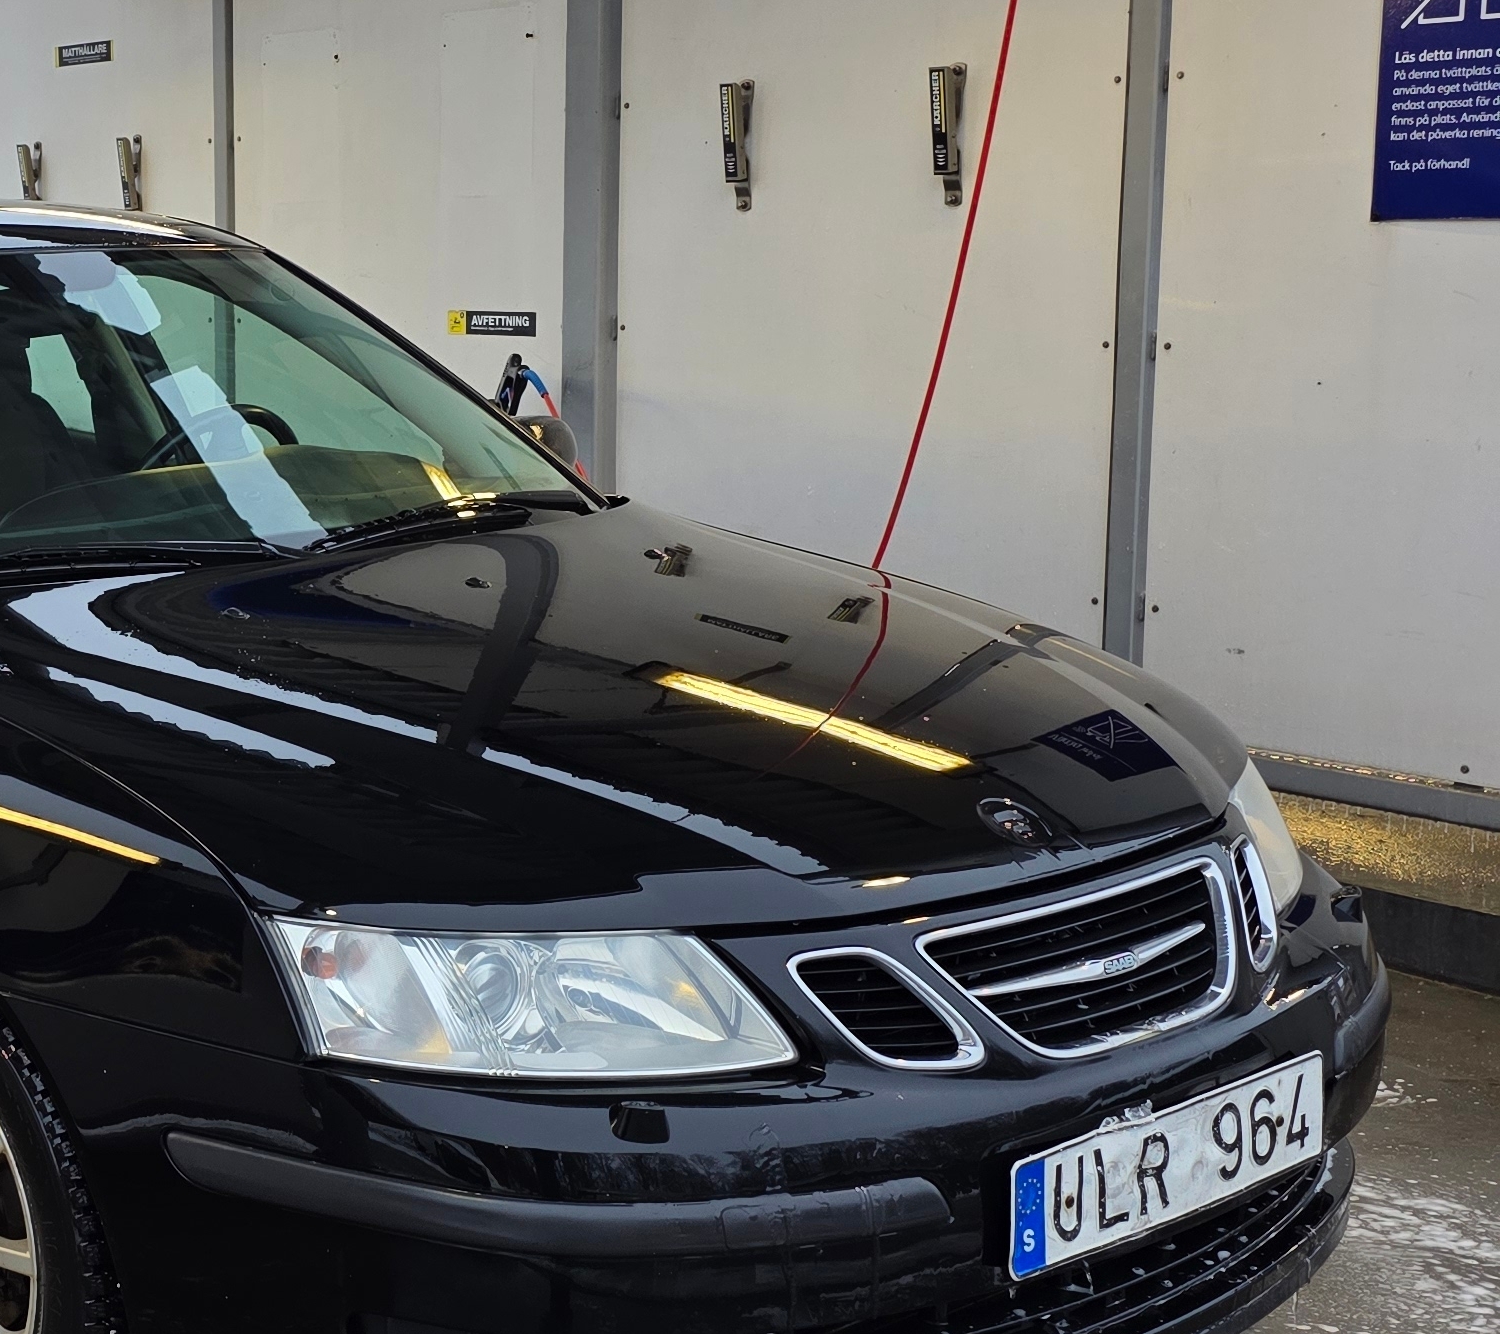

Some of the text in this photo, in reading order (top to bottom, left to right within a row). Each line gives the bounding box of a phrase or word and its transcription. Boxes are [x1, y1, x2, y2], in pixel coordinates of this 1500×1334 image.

[1394, 51, 1416, 64] Läs
[1418, 49, 1453, 63] detta
[1455, 47, 1493, 60] innan
[1393, 69, 1407, 81] På
[1408, 68, 1440, 80] denna
[1441, 65, 1492, 79] tvättplats
[1392, 83, 1436, 96] använda
[1437, 82, 1461, 96] eget
[1391, 99, 1425, 111] endast
[1426, 97, 1474, 112] anpassat
[1475, 95, 1491, 107] för
[1390, 114, 1414, 126] finns
[1415, 113, 1429, 128] på
[1430, 113, 1459, 127] plats.
[1390, 130, 1408, 141] kan
[1409, 129, 1426, 141] det
[1427, 127, 1468, 143] påverka
[1388, 157, 1471, 173] Tack på förhand!
[470, 314, 530, 327] AVFETTNING
[1104, 955, 1135, 974] SAAB
[1053, 1072, 1311, 1243] ULR 964
[1023, 1228, 1036, 1253] S
